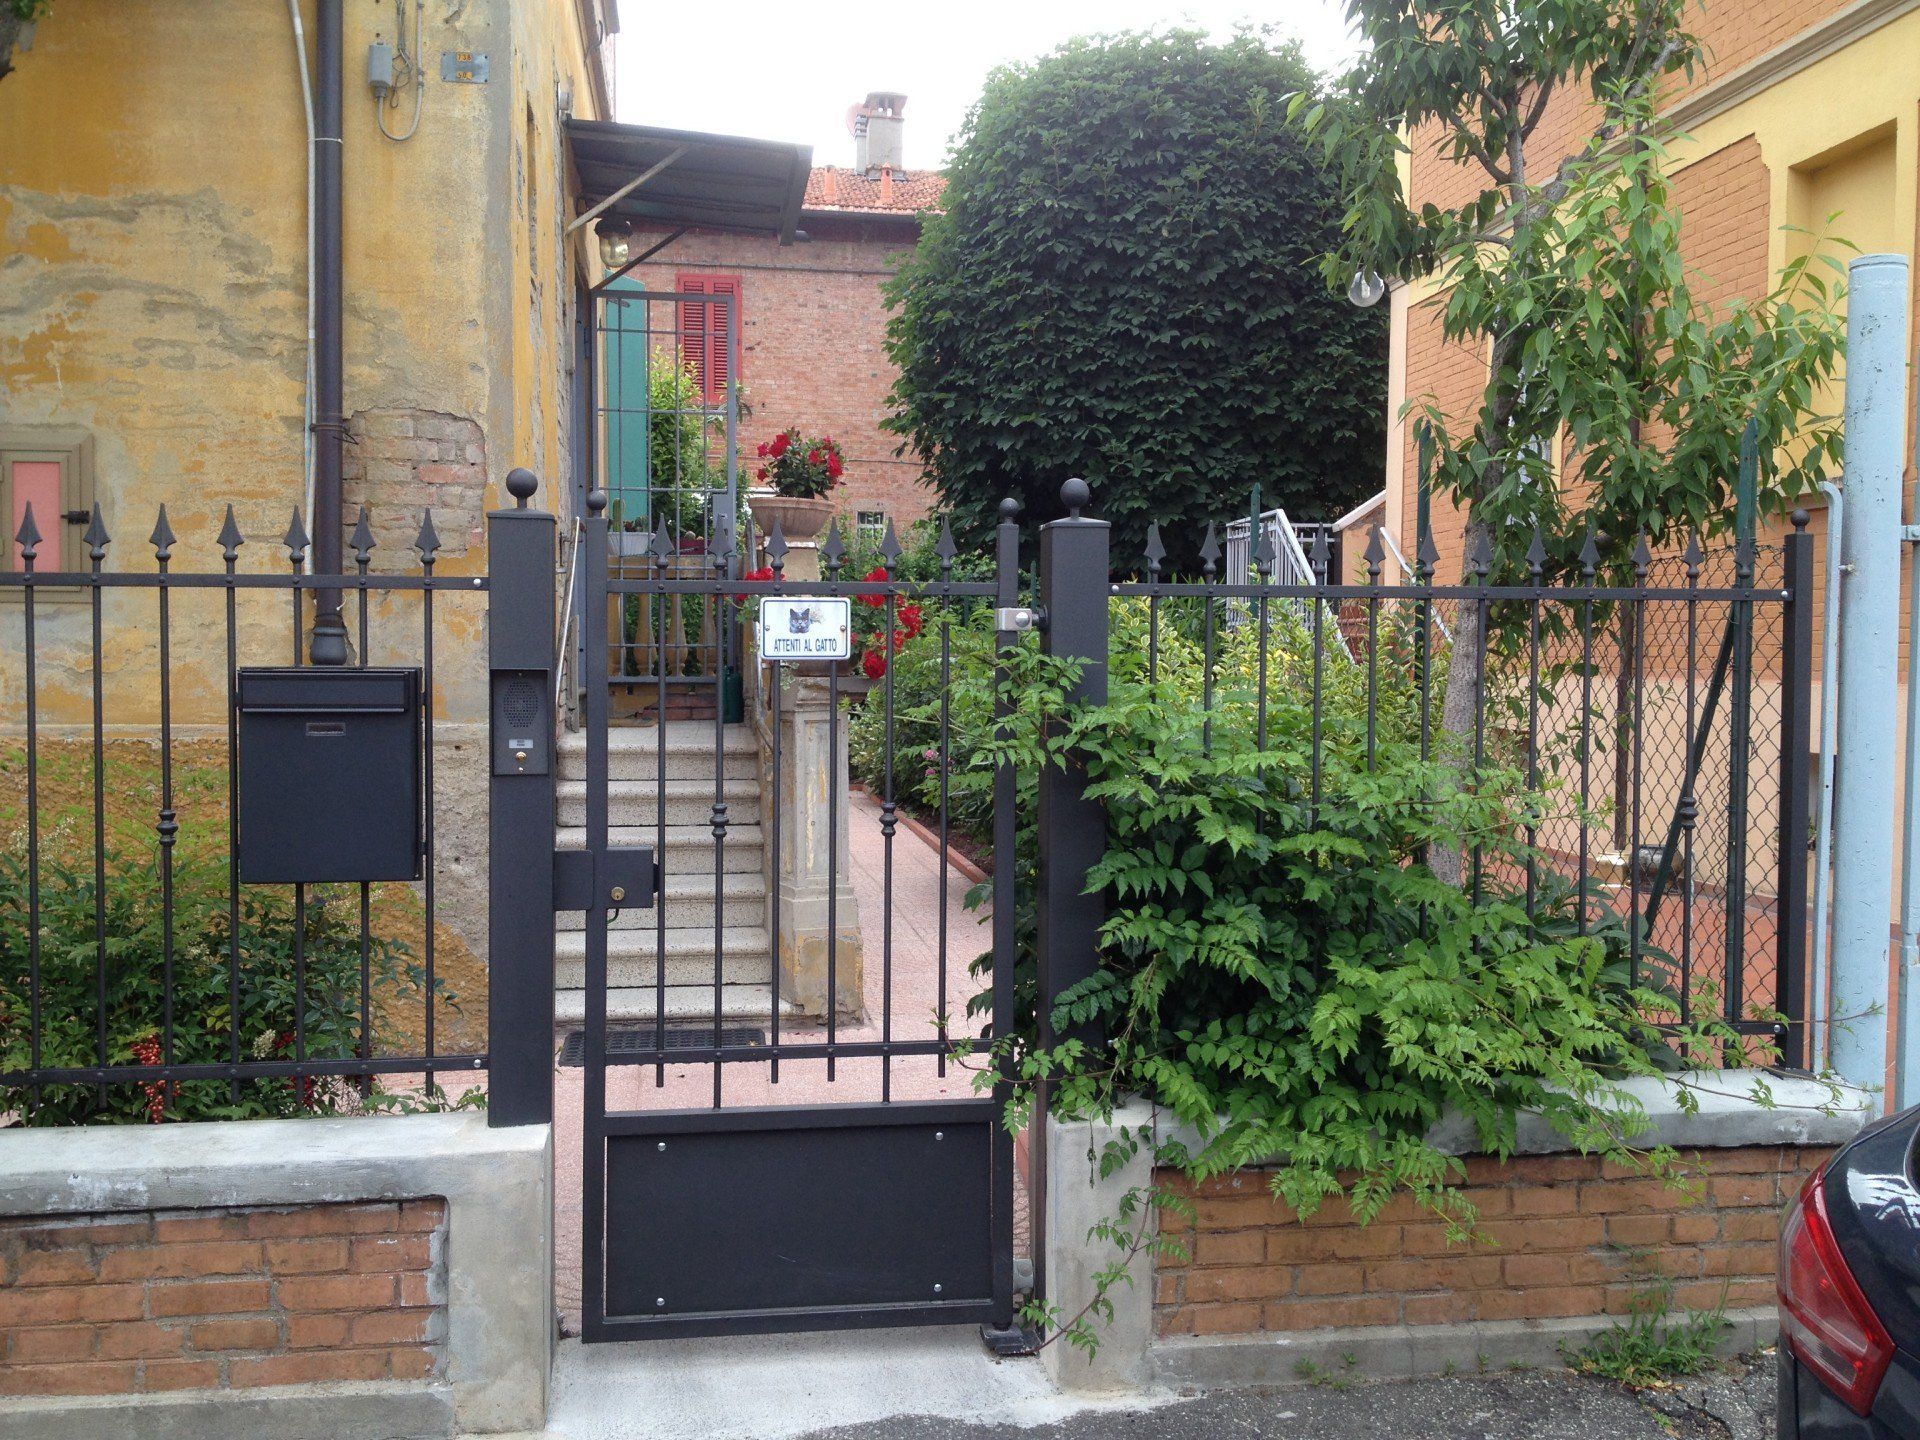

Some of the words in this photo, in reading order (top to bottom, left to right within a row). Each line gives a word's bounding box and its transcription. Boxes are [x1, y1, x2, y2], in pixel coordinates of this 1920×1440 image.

[773, 638, 801, 652] ATTENTI
[803, 638, 812, 652] AL
[815, 638, 837, 652] GATTO
